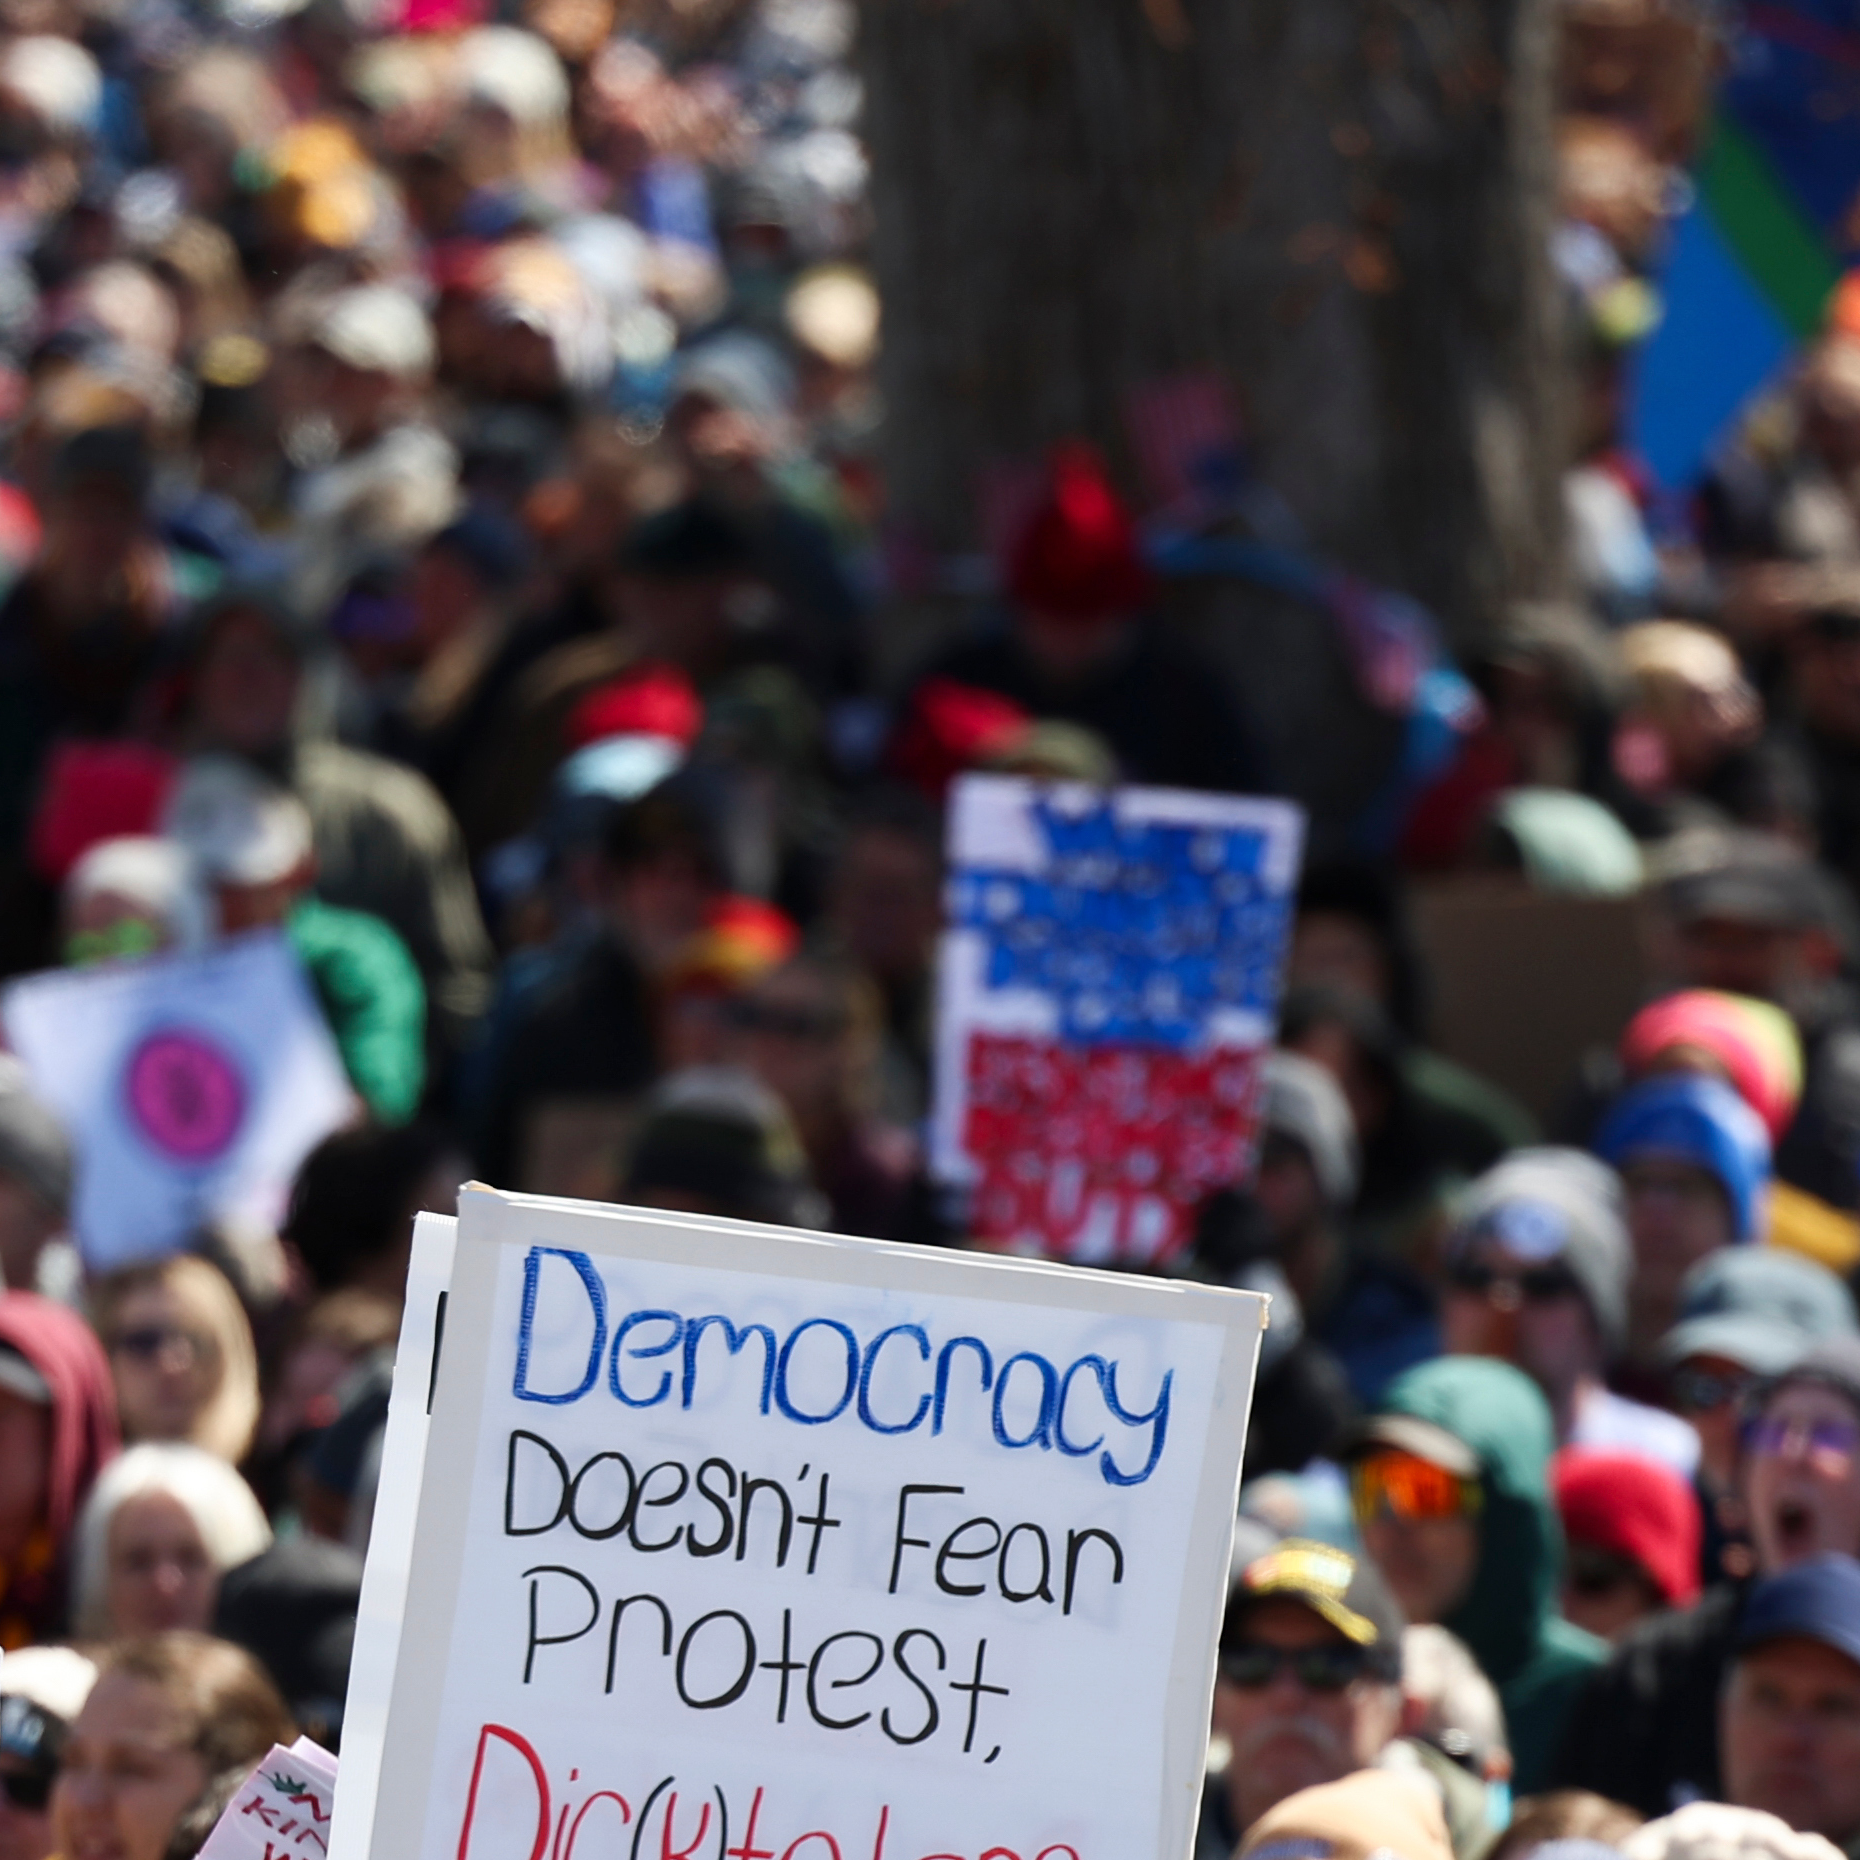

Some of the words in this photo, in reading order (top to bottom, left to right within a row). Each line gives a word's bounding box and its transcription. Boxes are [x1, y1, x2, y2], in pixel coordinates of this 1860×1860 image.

[513, 1246, 1174, 1485] Democracy
[505, 1430, 840, 1574] Doesn't
[889, 1485, 1123, 1615] Fear
[521, 1566, 1010, 1764] Protest,
